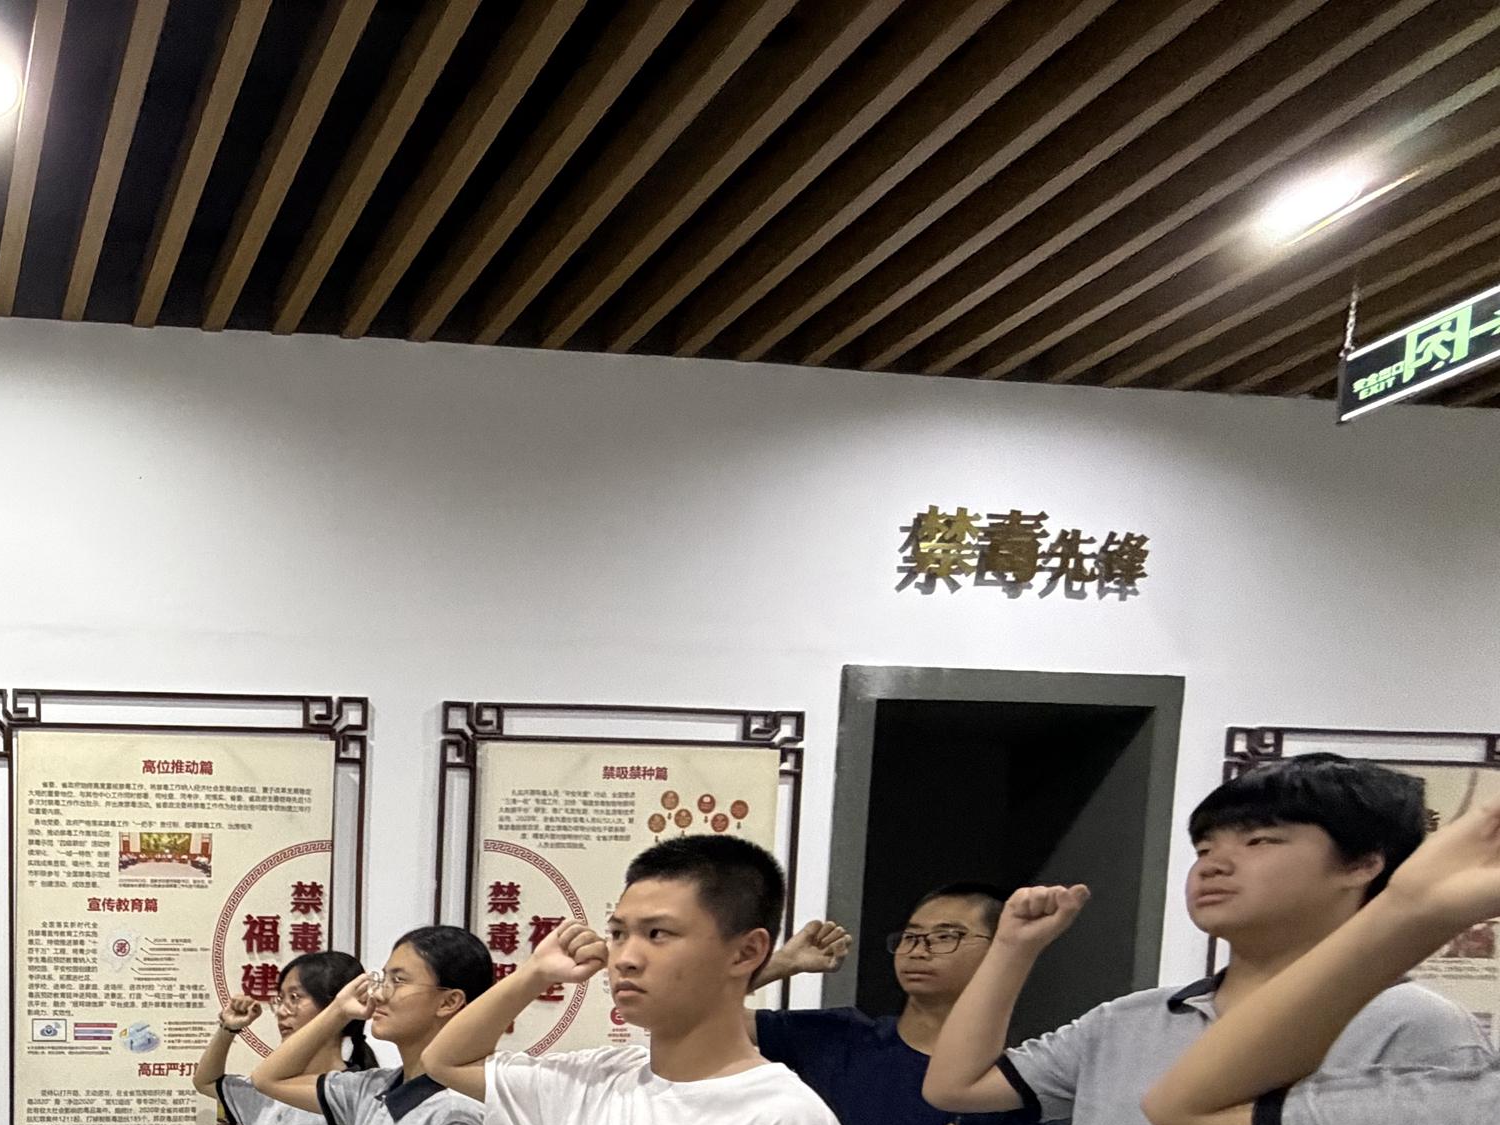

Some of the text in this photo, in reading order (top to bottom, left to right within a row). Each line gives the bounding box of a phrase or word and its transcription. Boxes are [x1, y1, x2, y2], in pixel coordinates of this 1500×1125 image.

[910, 505, 1150, 586] 禁毒先锋
[142, 759, 213, 775] 高位推动篇
[602, 764, 669, 782] 禁吸禁种篇
[87, 897, 158, 912] 宣传教育篇
[289, 881, 323, 953] 禁毒
[242, 914, 281, 1002] 福建
[138, 1063, 199, 1077] 高压严打
